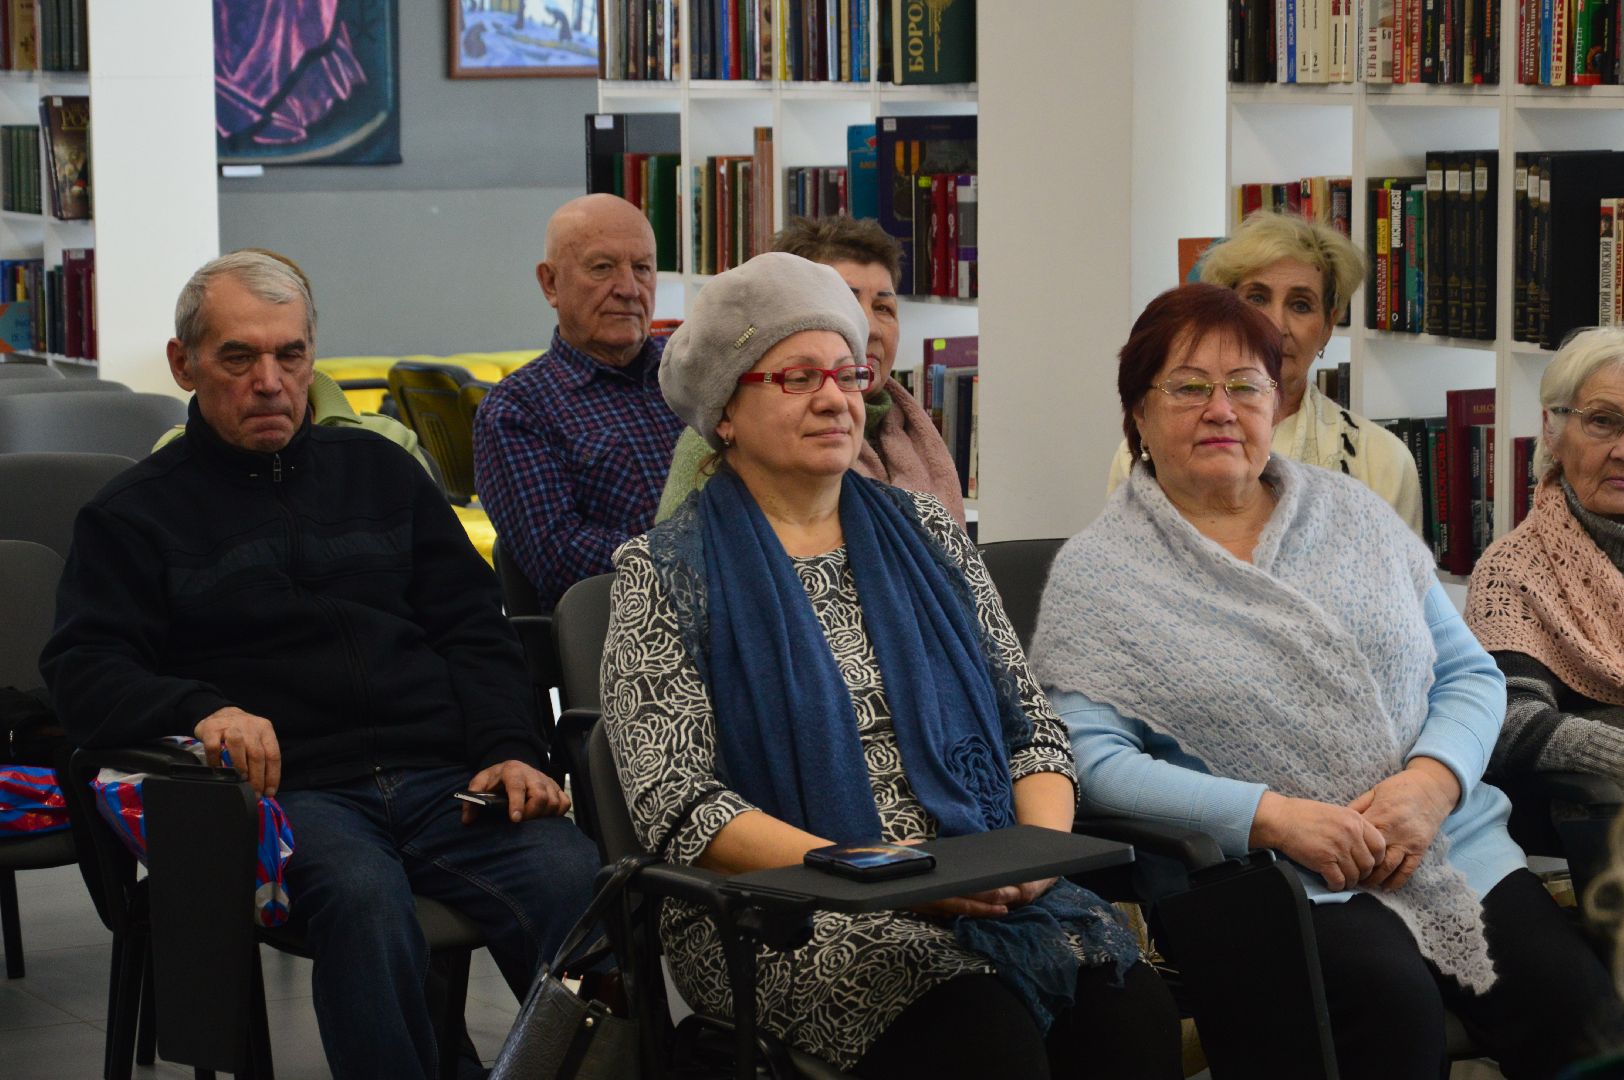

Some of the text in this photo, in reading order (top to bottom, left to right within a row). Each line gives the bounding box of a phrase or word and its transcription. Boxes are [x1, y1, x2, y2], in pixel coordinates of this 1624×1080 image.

[908, 0, 924, 72] БОРО
[1367, 27, 1377, 77] ЕЛЬЦИН
[1394, 49, 1402, 80] СТАЛИН
[1391, 189, 1403, 248] ДЗЕРЖИНСКИЙ
[1600, 240, 1612, 327] РИГОРИЙ КОТОВСКИЙ
